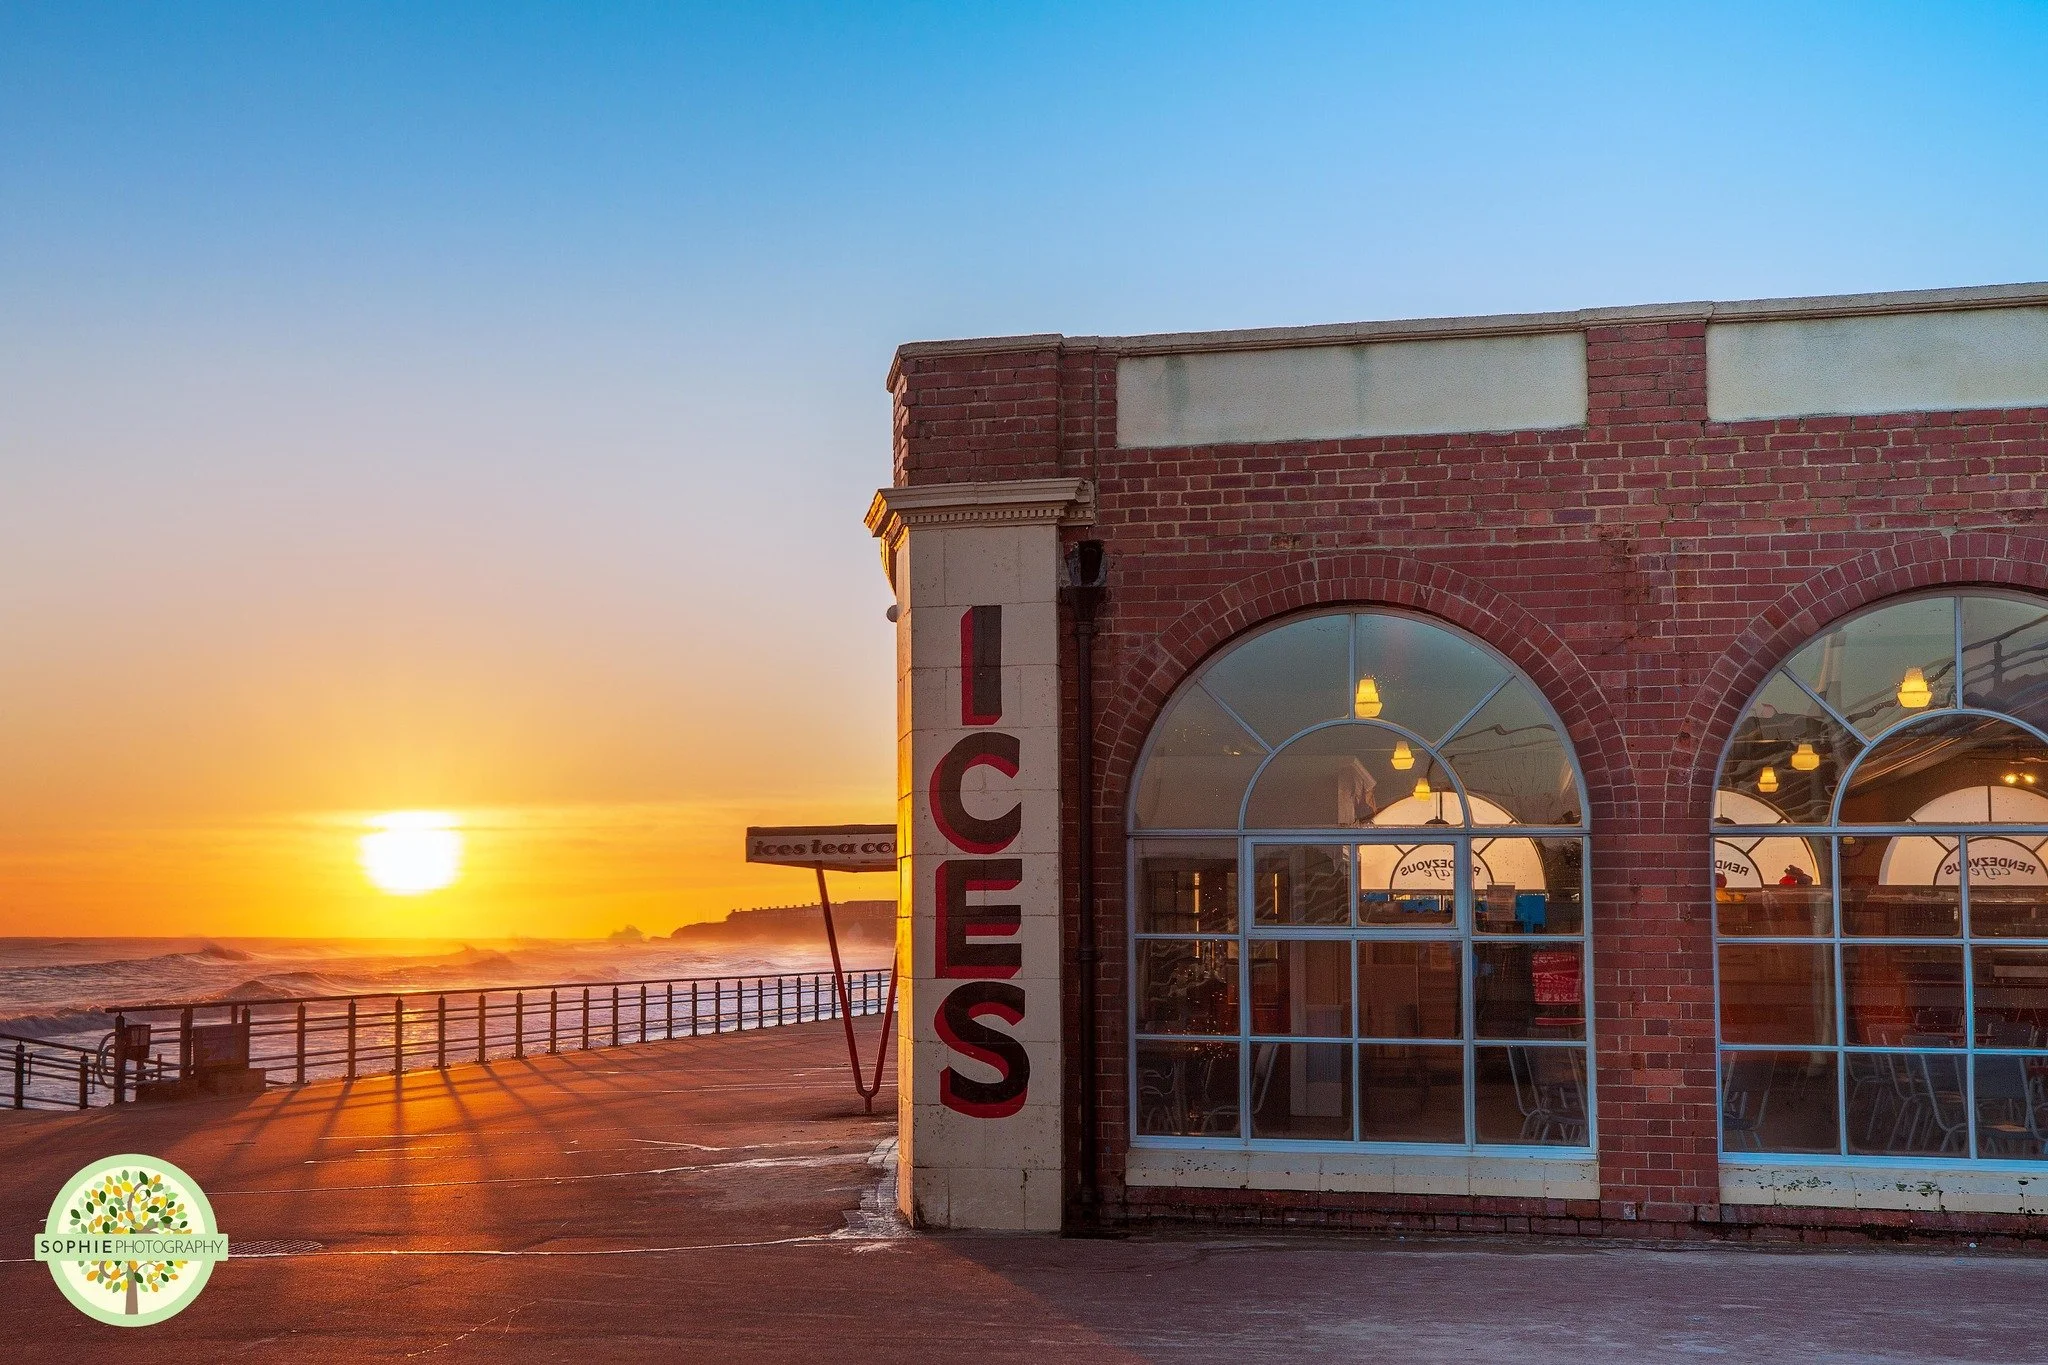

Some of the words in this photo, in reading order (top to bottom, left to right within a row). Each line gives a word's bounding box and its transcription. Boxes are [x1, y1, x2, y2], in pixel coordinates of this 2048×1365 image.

[753, 840, 807, 856] ices
[811, 839, 857, 855] tea
[929, 604, 1031, 1118] ICES
